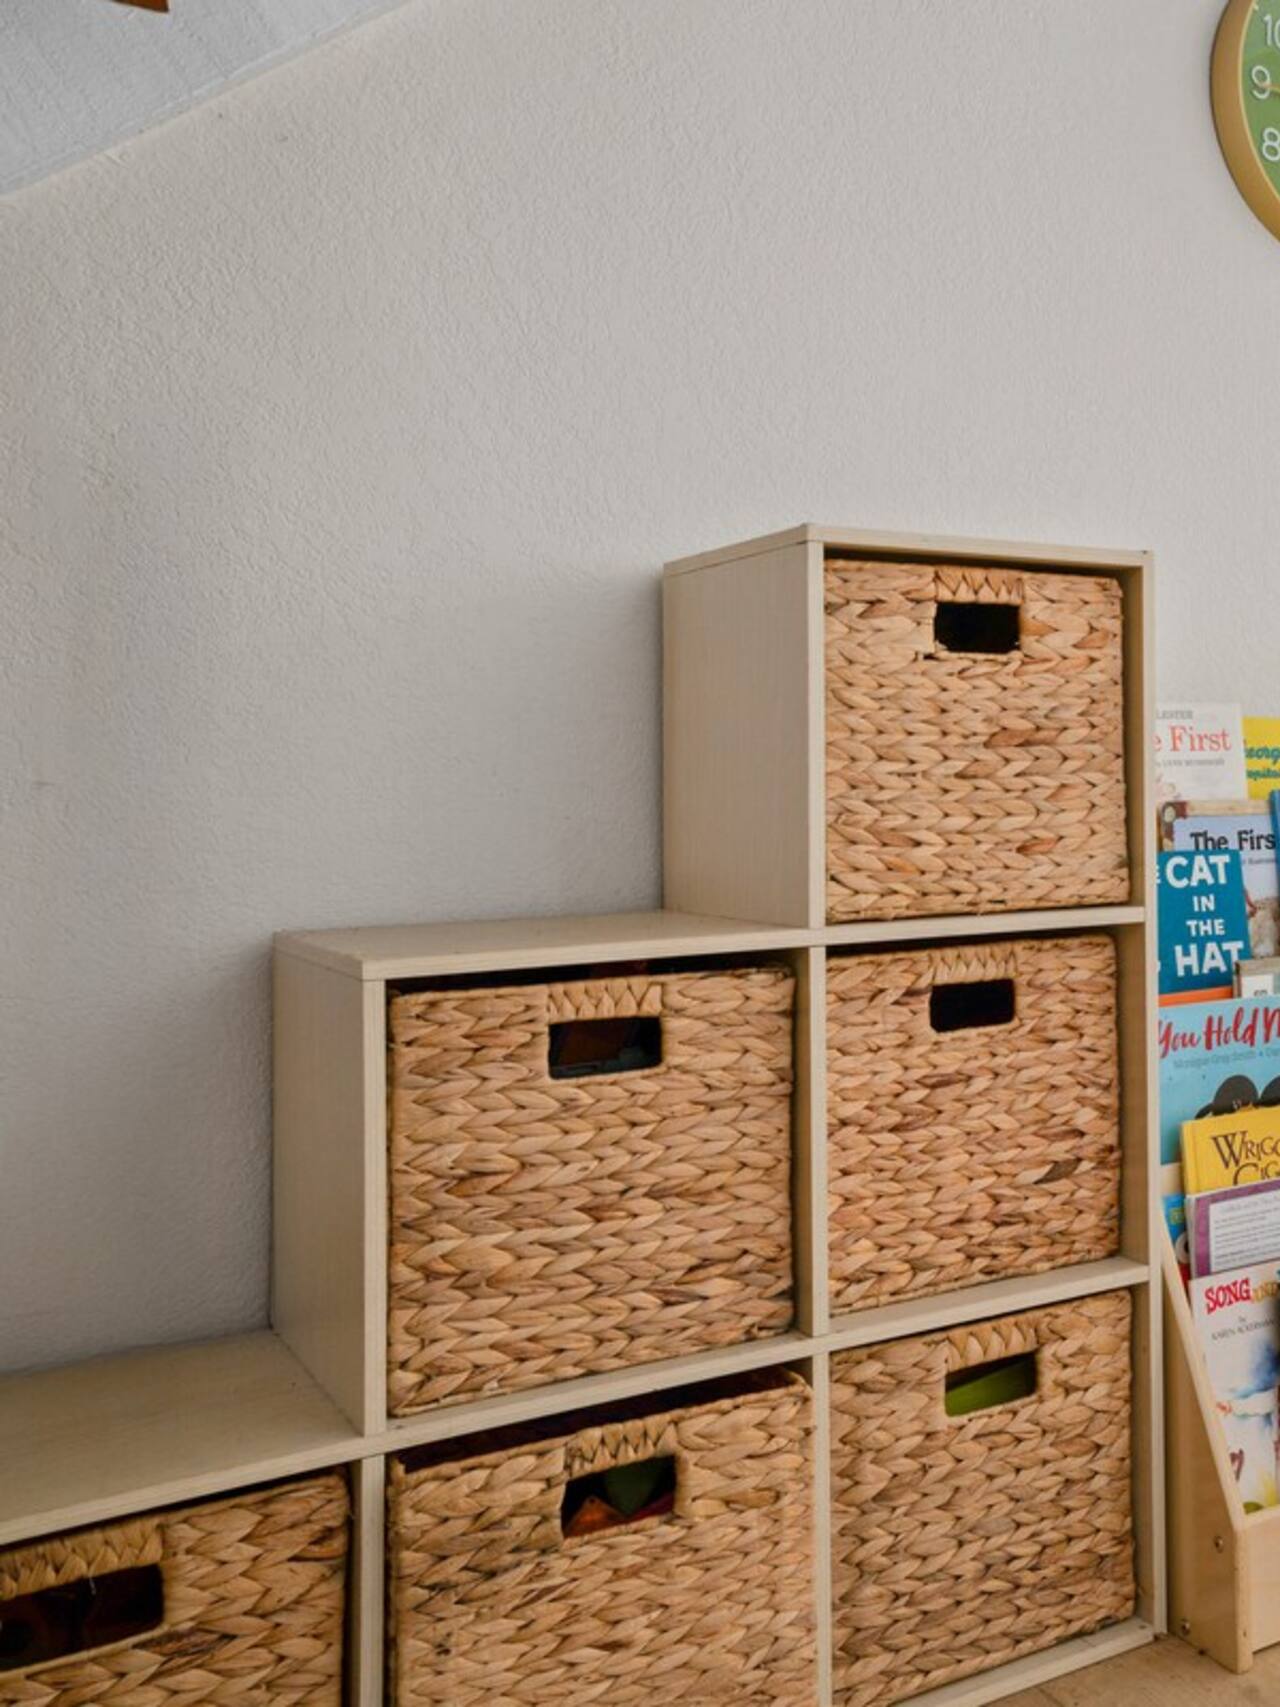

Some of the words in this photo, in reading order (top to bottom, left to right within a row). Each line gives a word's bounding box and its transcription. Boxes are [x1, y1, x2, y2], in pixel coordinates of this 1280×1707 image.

[1251, 65, 1271, 100] 9
[1168, 724, 1232, 752] First
[1189, 830, 1229, 850] The
[1237, 829, 1277, 850] Firs
[1166, 854, 1231, 889] CAT
[1193, 893, 1216, 912] IN
[1186, 919, 1226, 937] THE
[1174, 940, 1244, 978] HAT
[1158, 1020, 1201, 1059] You
[1204, 1006, 1260, 1051] Hold
[1204, 1277, 1251, 1315] SONG
